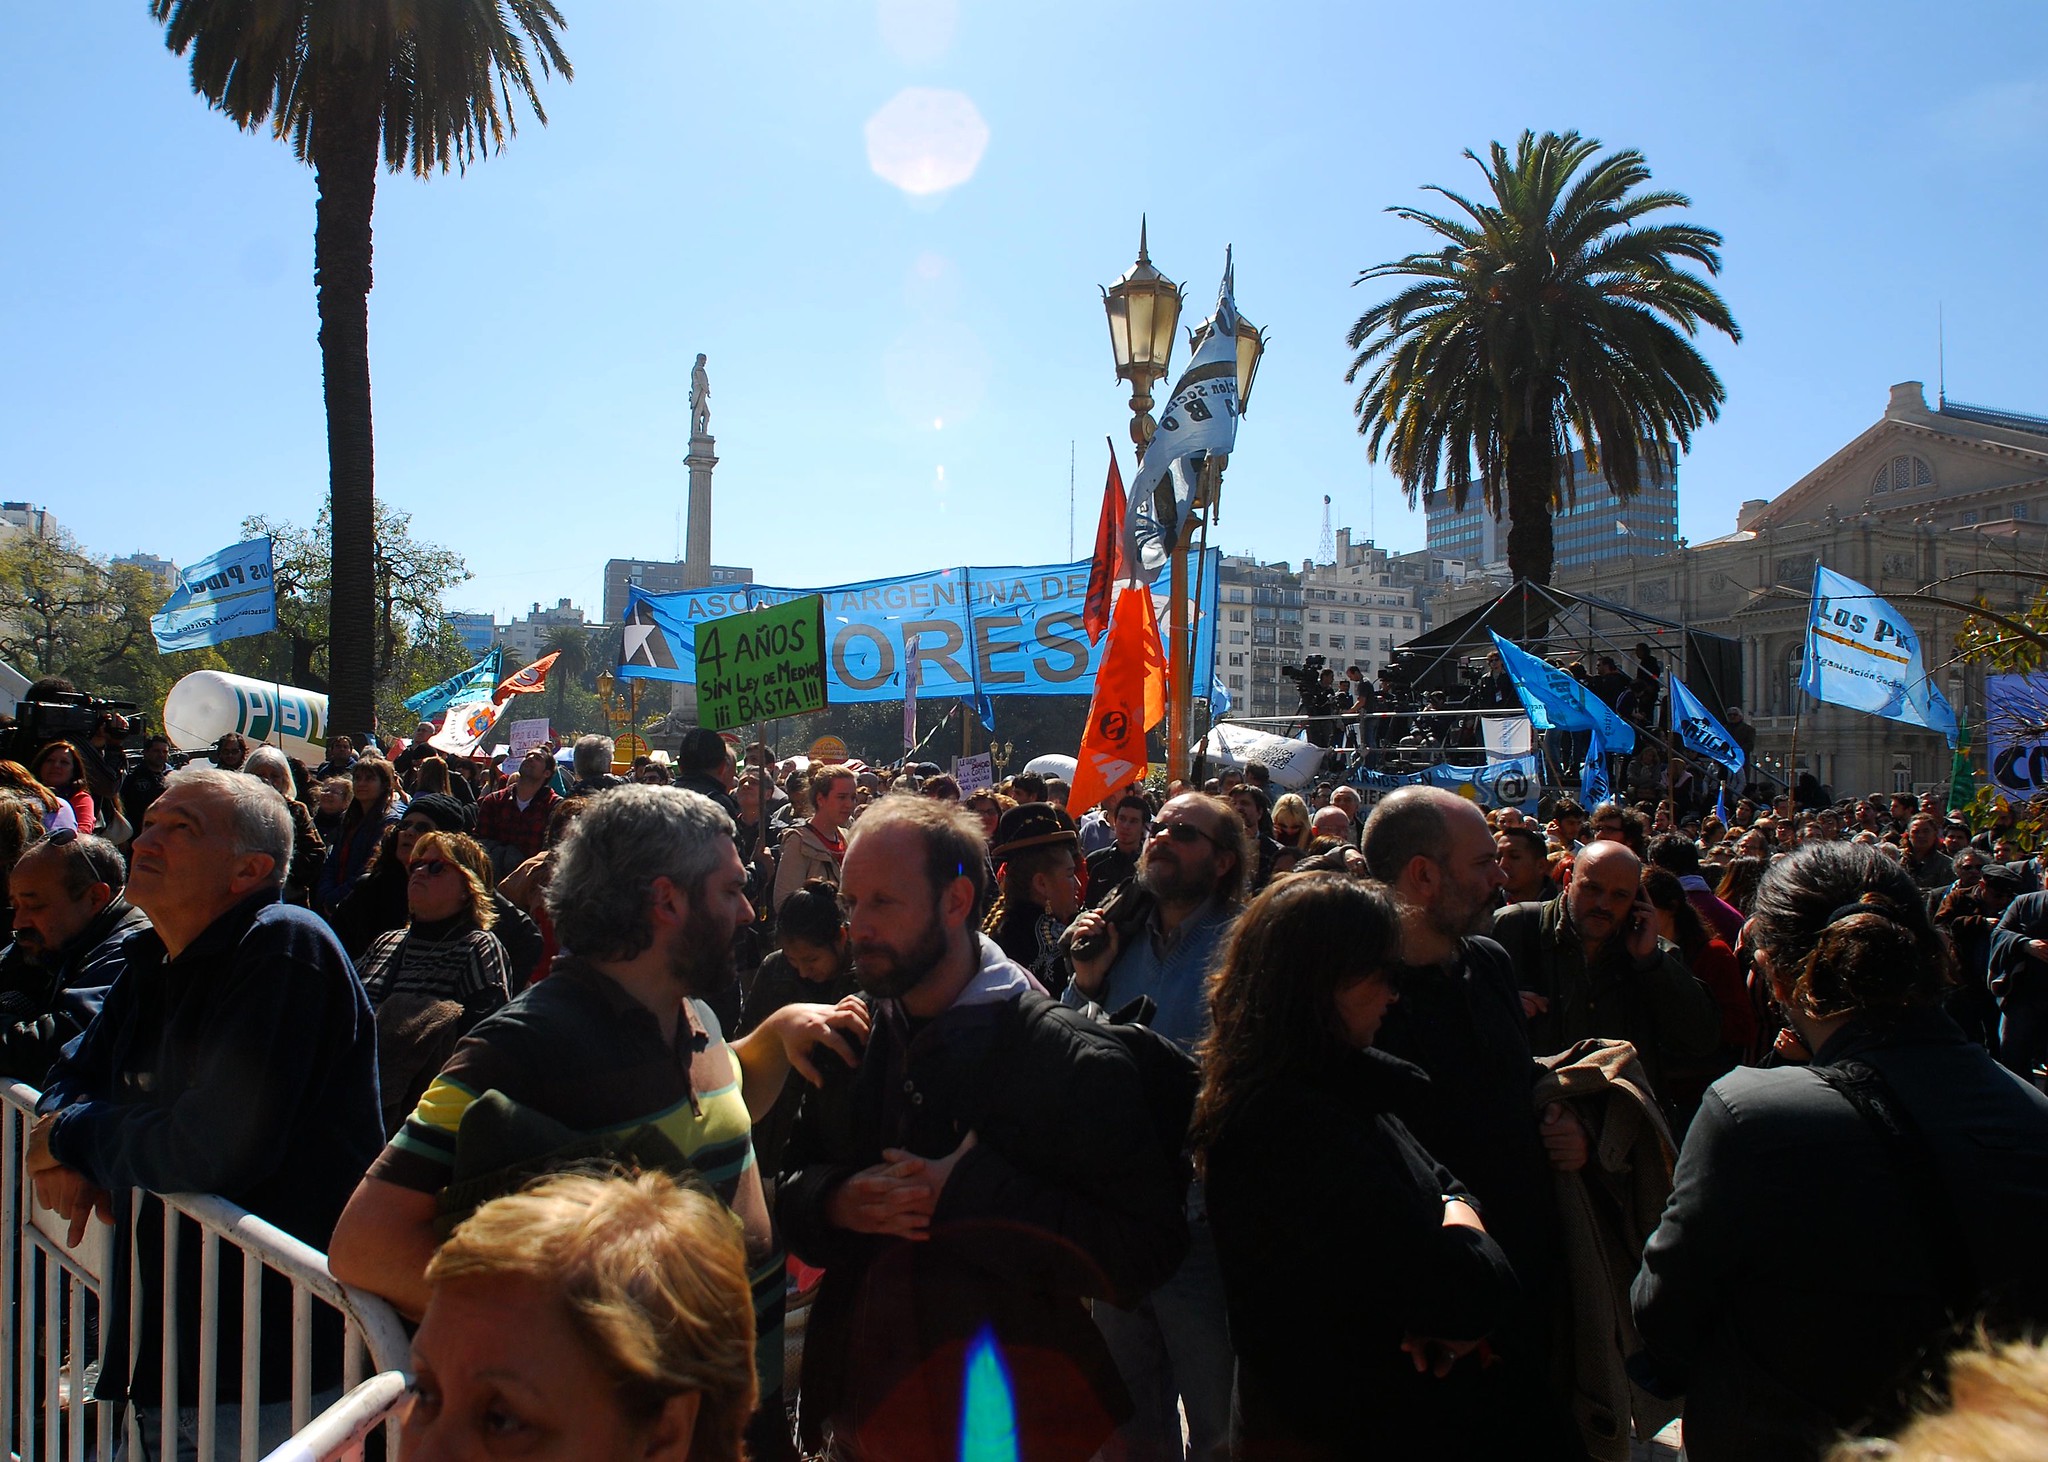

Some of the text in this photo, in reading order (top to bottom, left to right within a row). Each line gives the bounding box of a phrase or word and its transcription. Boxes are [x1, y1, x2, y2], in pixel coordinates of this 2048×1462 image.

[840, 579, 1031, 612] ARGENTINA
[1041, 573, 1088, 600] DE
[698, 619, 806, 677] 4 AÑOS
[763, 671, 775, 687] DE
[738, 686, 802, 721] BASTA
